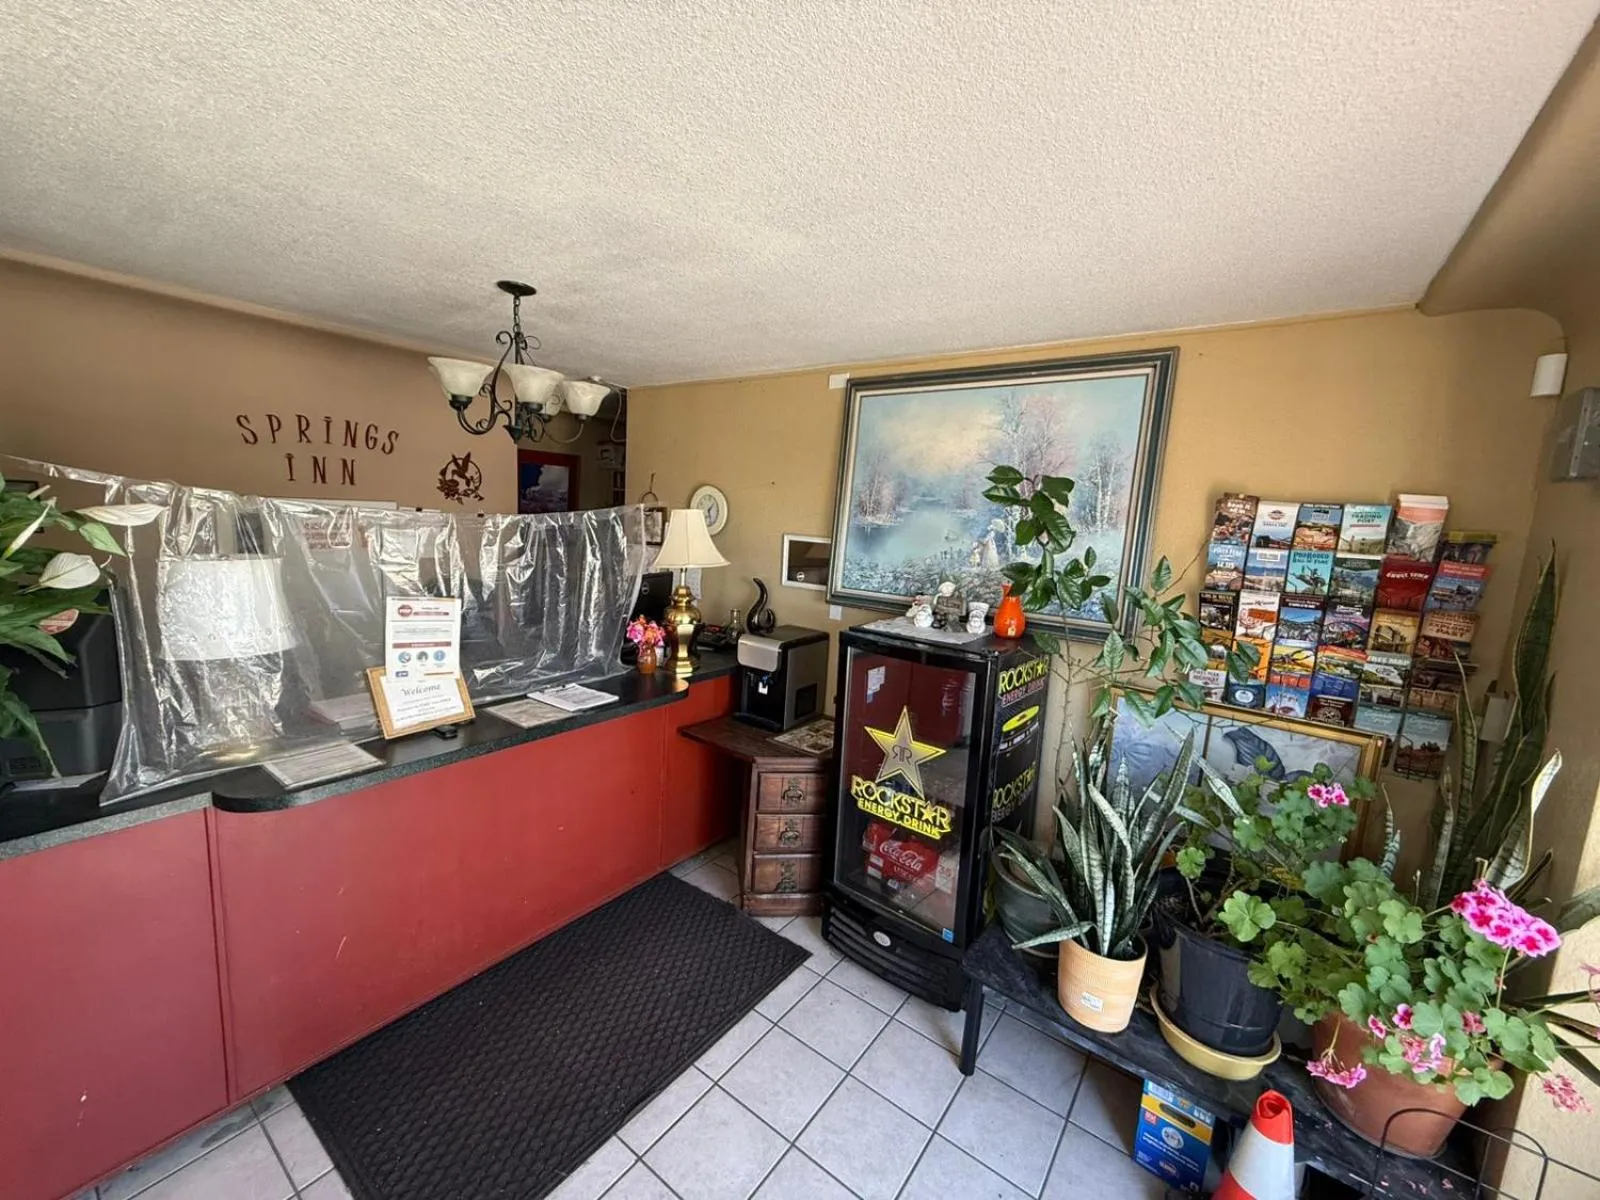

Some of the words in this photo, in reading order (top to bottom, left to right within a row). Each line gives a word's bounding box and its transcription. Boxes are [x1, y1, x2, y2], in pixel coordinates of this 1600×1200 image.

[236, 414, 399, 455] SPRINGS
[285, 453, 356, 485] INN
[400, 684, 441, 697] Welcome
[999, 656, 1049, 693] ROCKSTAR
[851, 775, 951, 832] ROCKSTAR
[858, 797, 900, 821] ENERGY
[903, 815, 940, 838] DRINK
